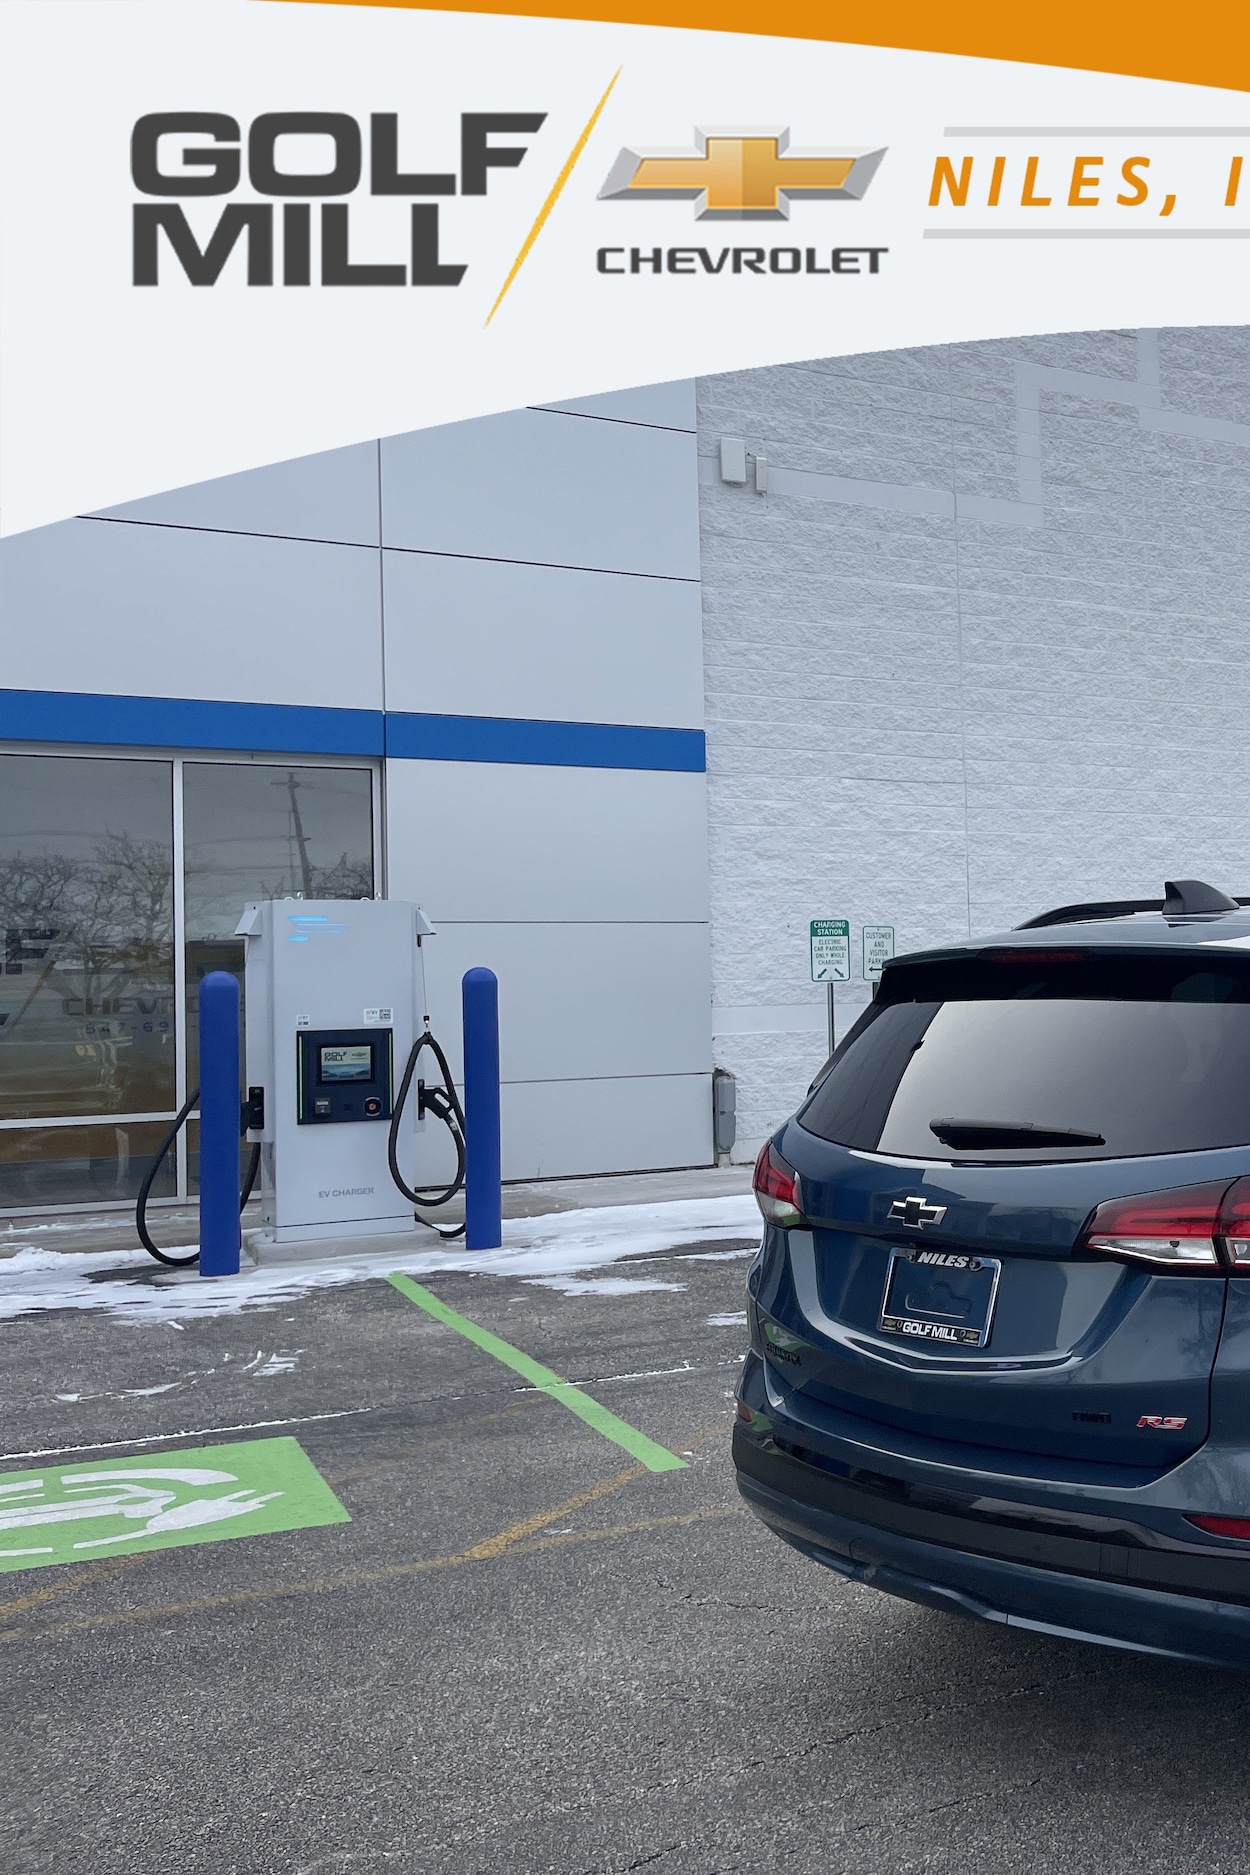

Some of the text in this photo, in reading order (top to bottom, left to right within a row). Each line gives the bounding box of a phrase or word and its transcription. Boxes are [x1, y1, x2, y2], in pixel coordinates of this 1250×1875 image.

[813, 921, 846, 929] CHARGING
[318, 1187, 375, 1199] EV CHARGER
[917, 1251, 970, 1269] NILES
[902, 1321, 958, 1341] GOLF MILL
[1136, 1415, 1188, 1430] RS
